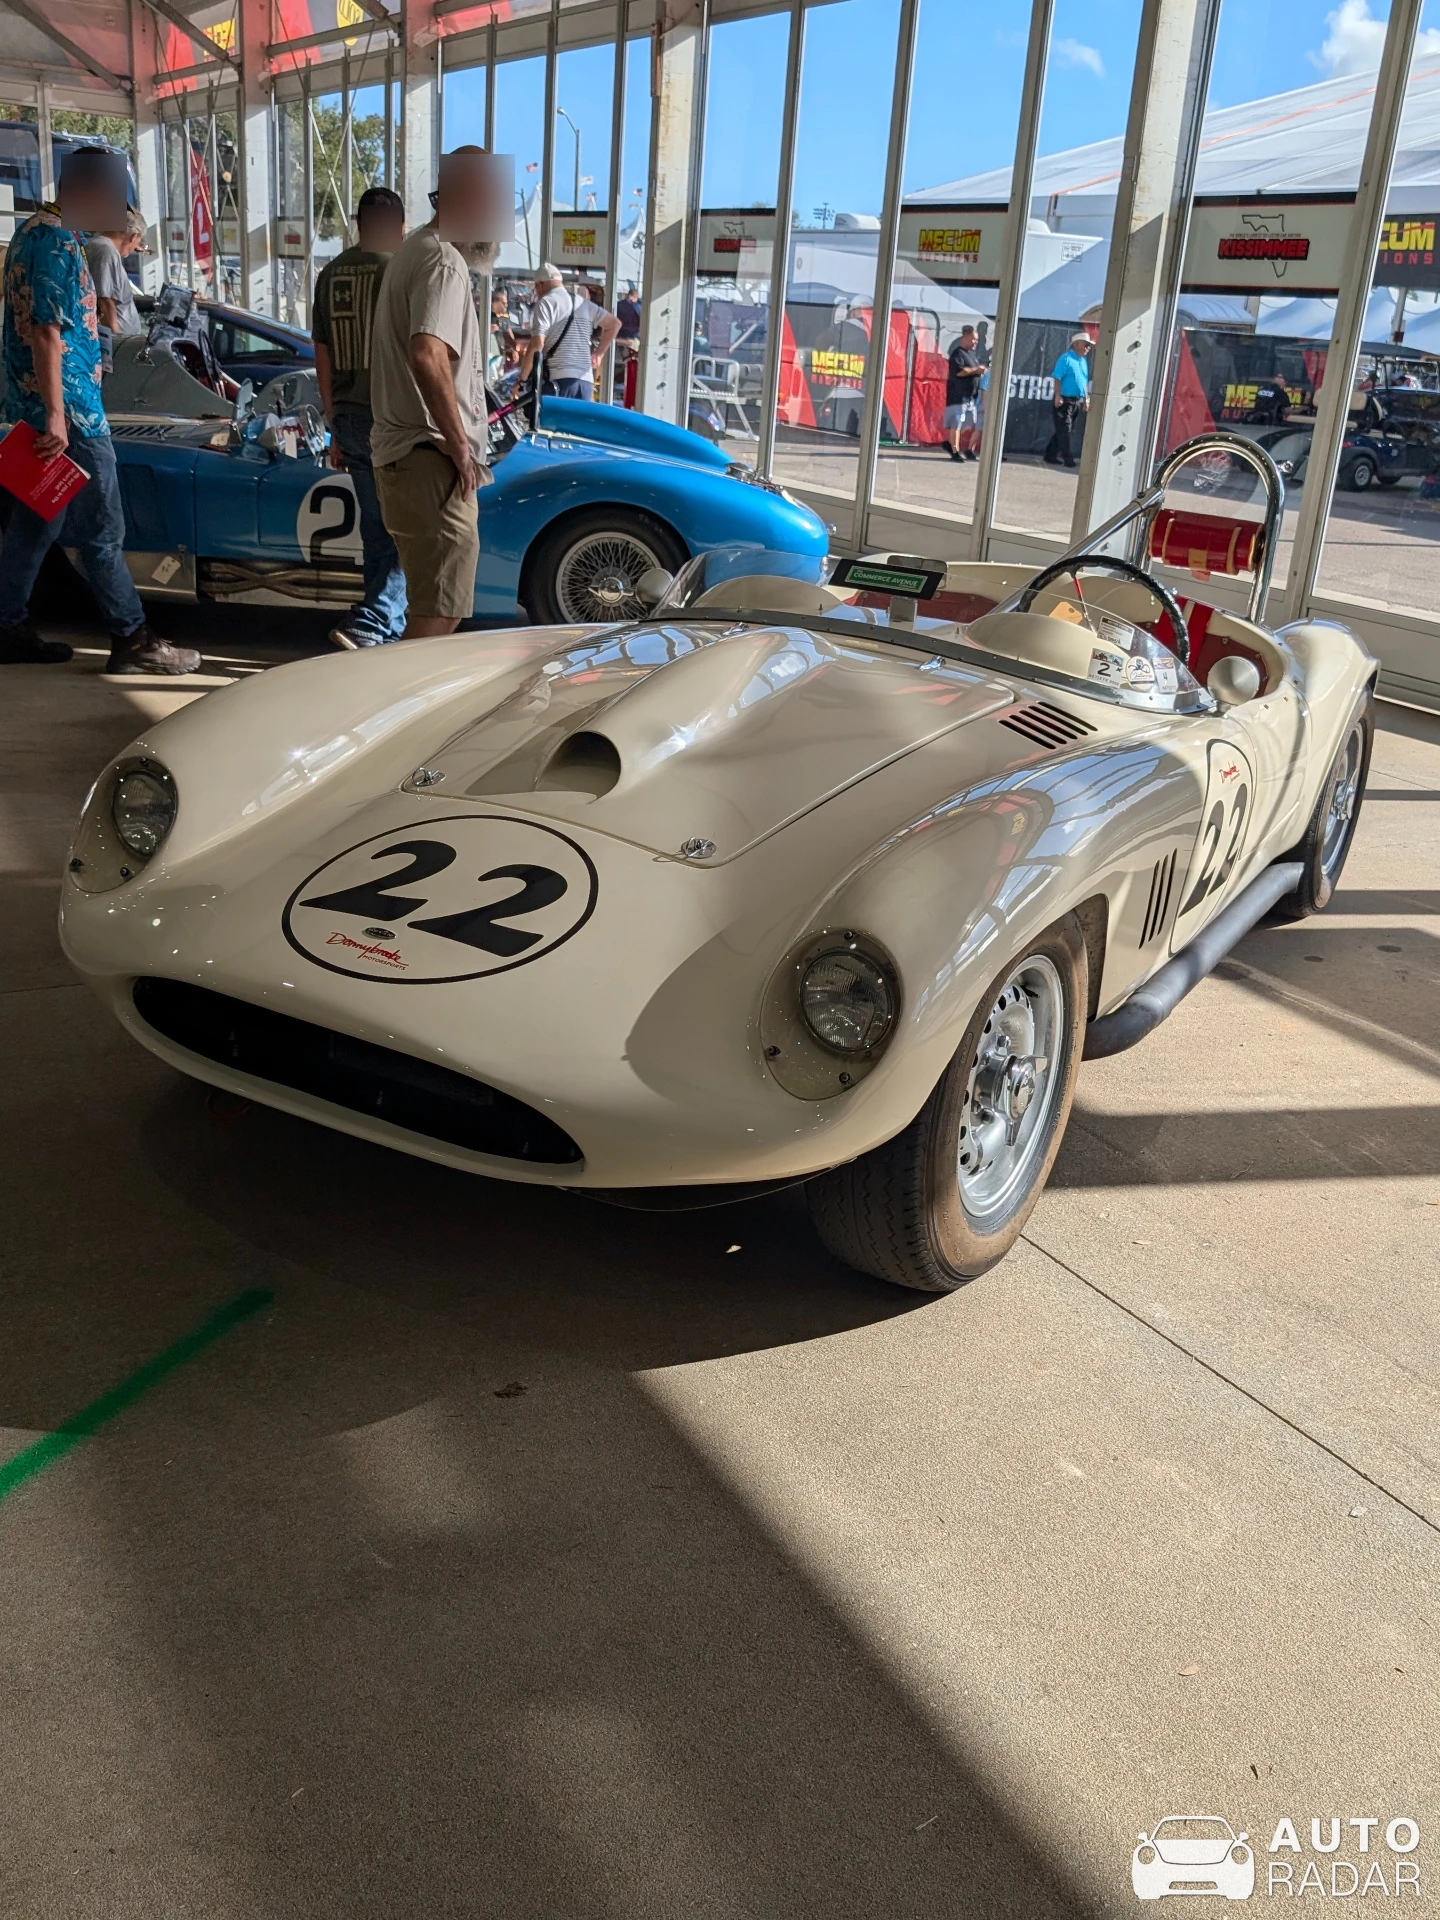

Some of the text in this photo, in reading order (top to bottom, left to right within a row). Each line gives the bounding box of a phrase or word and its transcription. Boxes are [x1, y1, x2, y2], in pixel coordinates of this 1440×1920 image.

[918, 230, 981, 252] MECUM
[1217, 238, 1310, 260] KISSIMMEE
[811, 350, 866, 379] MECUM
[310, 485, 356, 565] 2
[853, 572, 891, 583] COMMERCE
[891, 577, 919, 587] AVENUE
[1097, 662, 1111, 678] 2
[1178, 783, 1247, 918] 22
[298, 839, 569, 958] 22
[362, 954, 407, 971] MOTORSPORTS
